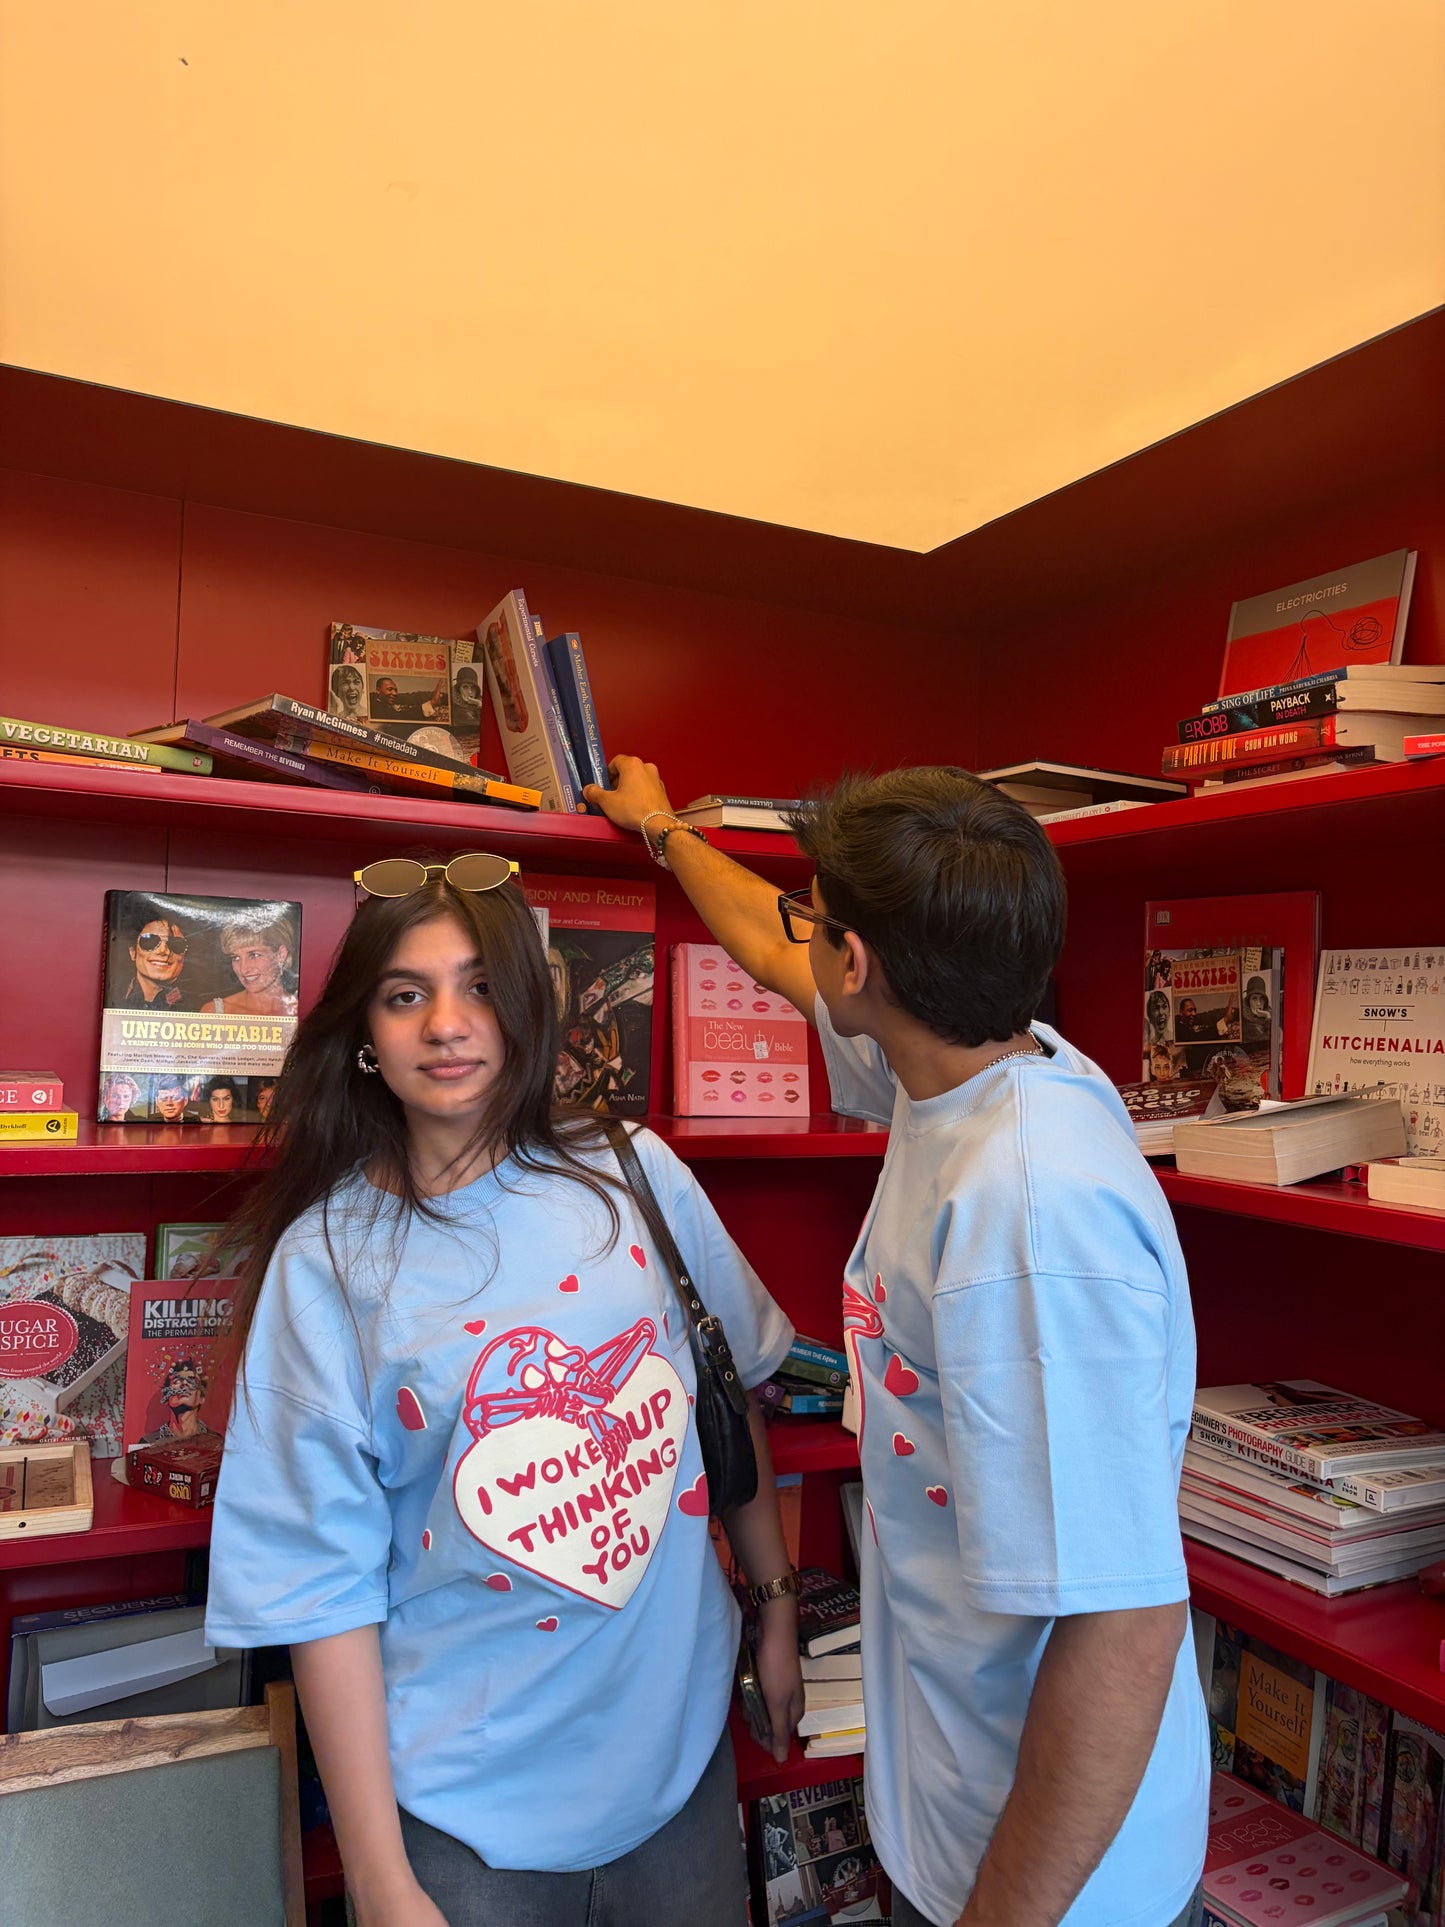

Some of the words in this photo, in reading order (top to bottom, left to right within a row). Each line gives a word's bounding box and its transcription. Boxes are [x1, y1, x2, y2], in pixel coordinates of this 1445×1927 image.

[1276, 583, 1348, 612] ELECTRICITIES
[517, 598, 532, 642] Experimental
[529, 641, 539, 668] Corsets
[369, 650, 447, 671] SIXTIES
[574, 653, 583, 680] Mother
[579, 680, 587, 703] Earth,
[584, 703, 592, 724] Sister
[588, 724, 598, 742] Seed
[1221, 697, 1241, 711] SING
[1242, 694, 1254, 705] OF
[1255, 688, 1275, 701] LIFE
[1270, 693, 1311, 712] PAYBACK
[1276, 712, 1284, 720] IN
[1284, 706, 1306, 719] DEATH
[290, 701, 315, 719] Ryan
[316, 710, 368, 738] McGinness
[374, 733, 418, 757] #metadata
[1194, 714, 1229, 739] ROBB
[2, 721, 150, 760] VEGETARIAN
[224, 737, 264, 757] REMEMBER
[265, 751, 279, 763] THE
[1183, 743, 1208, 767] PARTY
[1209, 741, 1220, 762] OF
[1222, 737, 1237, 760] ONE
[1244, 738, 1261, 751] CHUN
[1263, 735, 1277, 747] HAN
[1279, 731, 1298, 744] WONG
[326, 748, 361, 764] Make
[367, 754, 378, 769] It
[384, 760, 440, 781] Yourself
[1237, 769, 1251, 777] THE
[1253, 764, 1281, 775] SECRET
[563, 892, 590, 904] AND
[596, 890, 644, 906] REALITY
[1174, 966, 1237, 989] SIXTIES
[1364, 1008, 1407, 1017] SNOW'S
[121, 1020, 282, 1043] UNFORGETTABLE
[708, 1020, 723, 1030] The
[726, 1021, 744, 1031] New
[774, 1042, 793, 1052] Bible
[1323, 1035, 1445, 1054] KITCHENALIA
[1363, 1058, 1392, 1067] everything
[609, 1093, 626, 1101] ASHA
[627, 1093, 646, 1101] NATH
[144, 1299, 234, 1318] KILLING
[1, 1319, 58, 1335] UGAR
[0, 1334, 59, 1350] SPICE
[1246, 1401, 1381, 1422] BEGINNER'S
[1252, 1411, 1388, 1431] PHOTOGRAPHY
[477, 1486, 493, 1515] I
[496, 1437, 602, 1497] WOKE
[625, 1388, 671, 1441] UP
[1200, 1431, 1232, 1449] SNOW'S
[1228, 1426, 1284, 1457] PHOTOGRAPHY
[1285, 1449, 1307, 1469] GUIDE
[169, 1483, 191, 1500] UNO
[507, 1437, 677, 1552] THINKING
[1342, 1487, 1358, 1496] SNOW
[1343, 1482, 1358, 1491] ALAN
[590, 1508, 632, 1550] OF
[582, 1525, 651, 1585] YOU
[63, 1595, 188, 1619] SEQUENCE
[799, 1589, 860, 1615] Mantel
[1249, 1666, 1289, 1704] Make
[1294, 1693, 1305, 1716] It
[1249, 1687, 1307, 1738] Yourself
